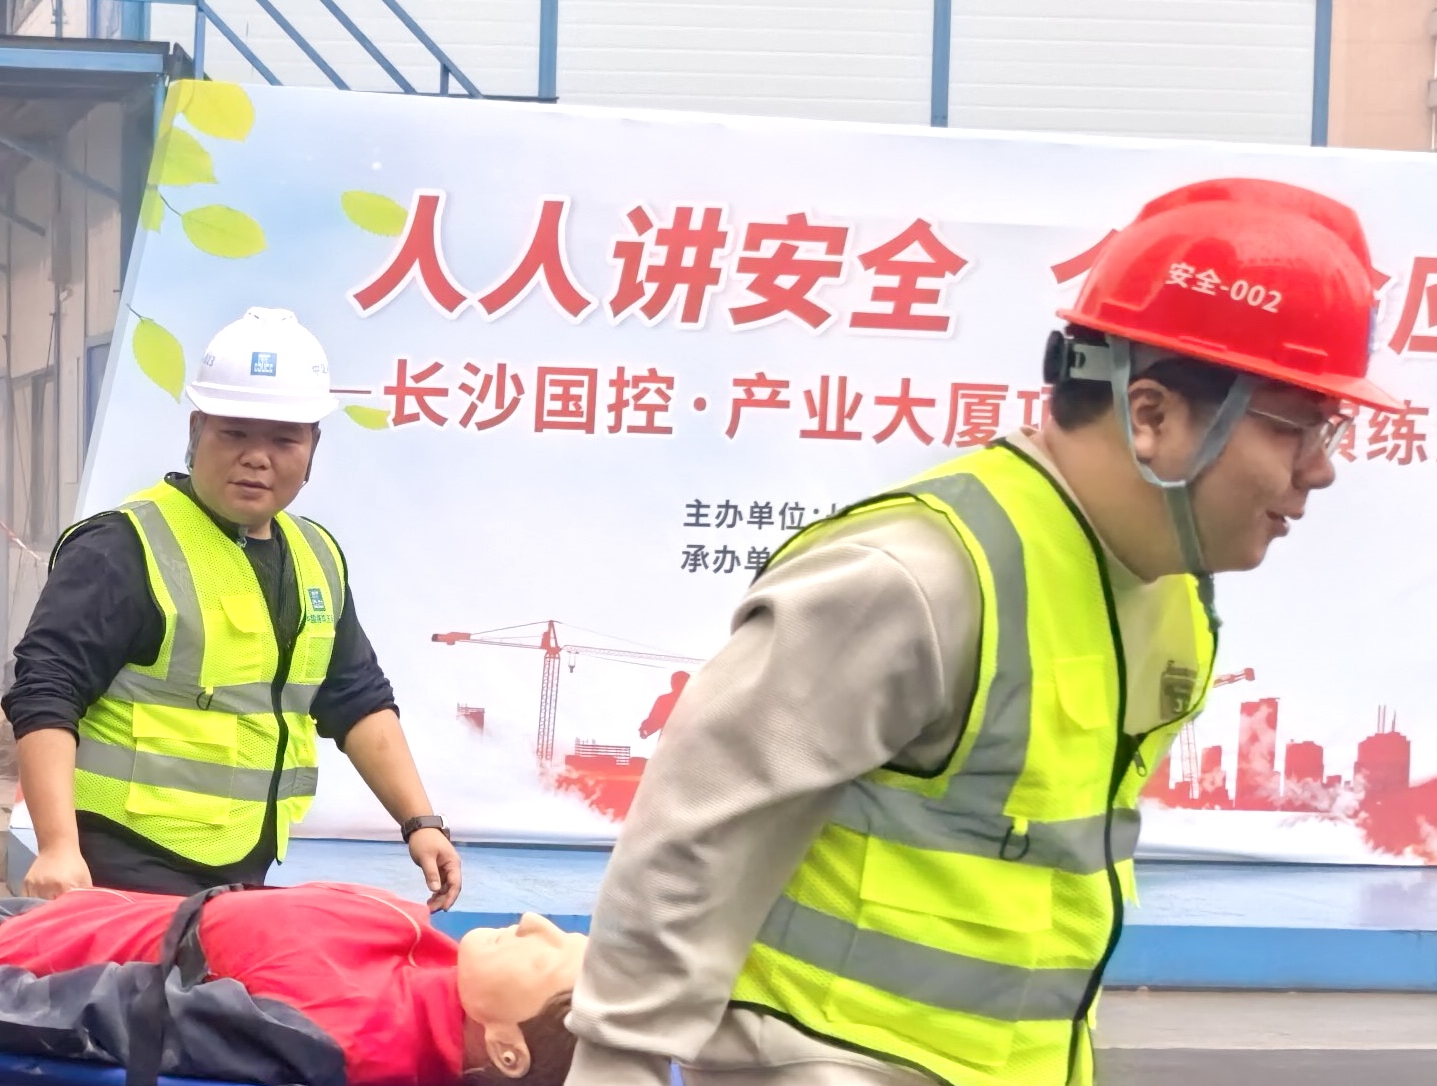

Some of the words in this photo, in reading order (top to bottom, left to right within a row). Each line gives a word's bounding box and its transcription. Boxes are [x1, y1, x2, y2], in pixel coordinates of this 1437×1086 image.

[352, 193, 968, 332] 人人讲安全
[1165, 262, 1283, 313] 安全-002
